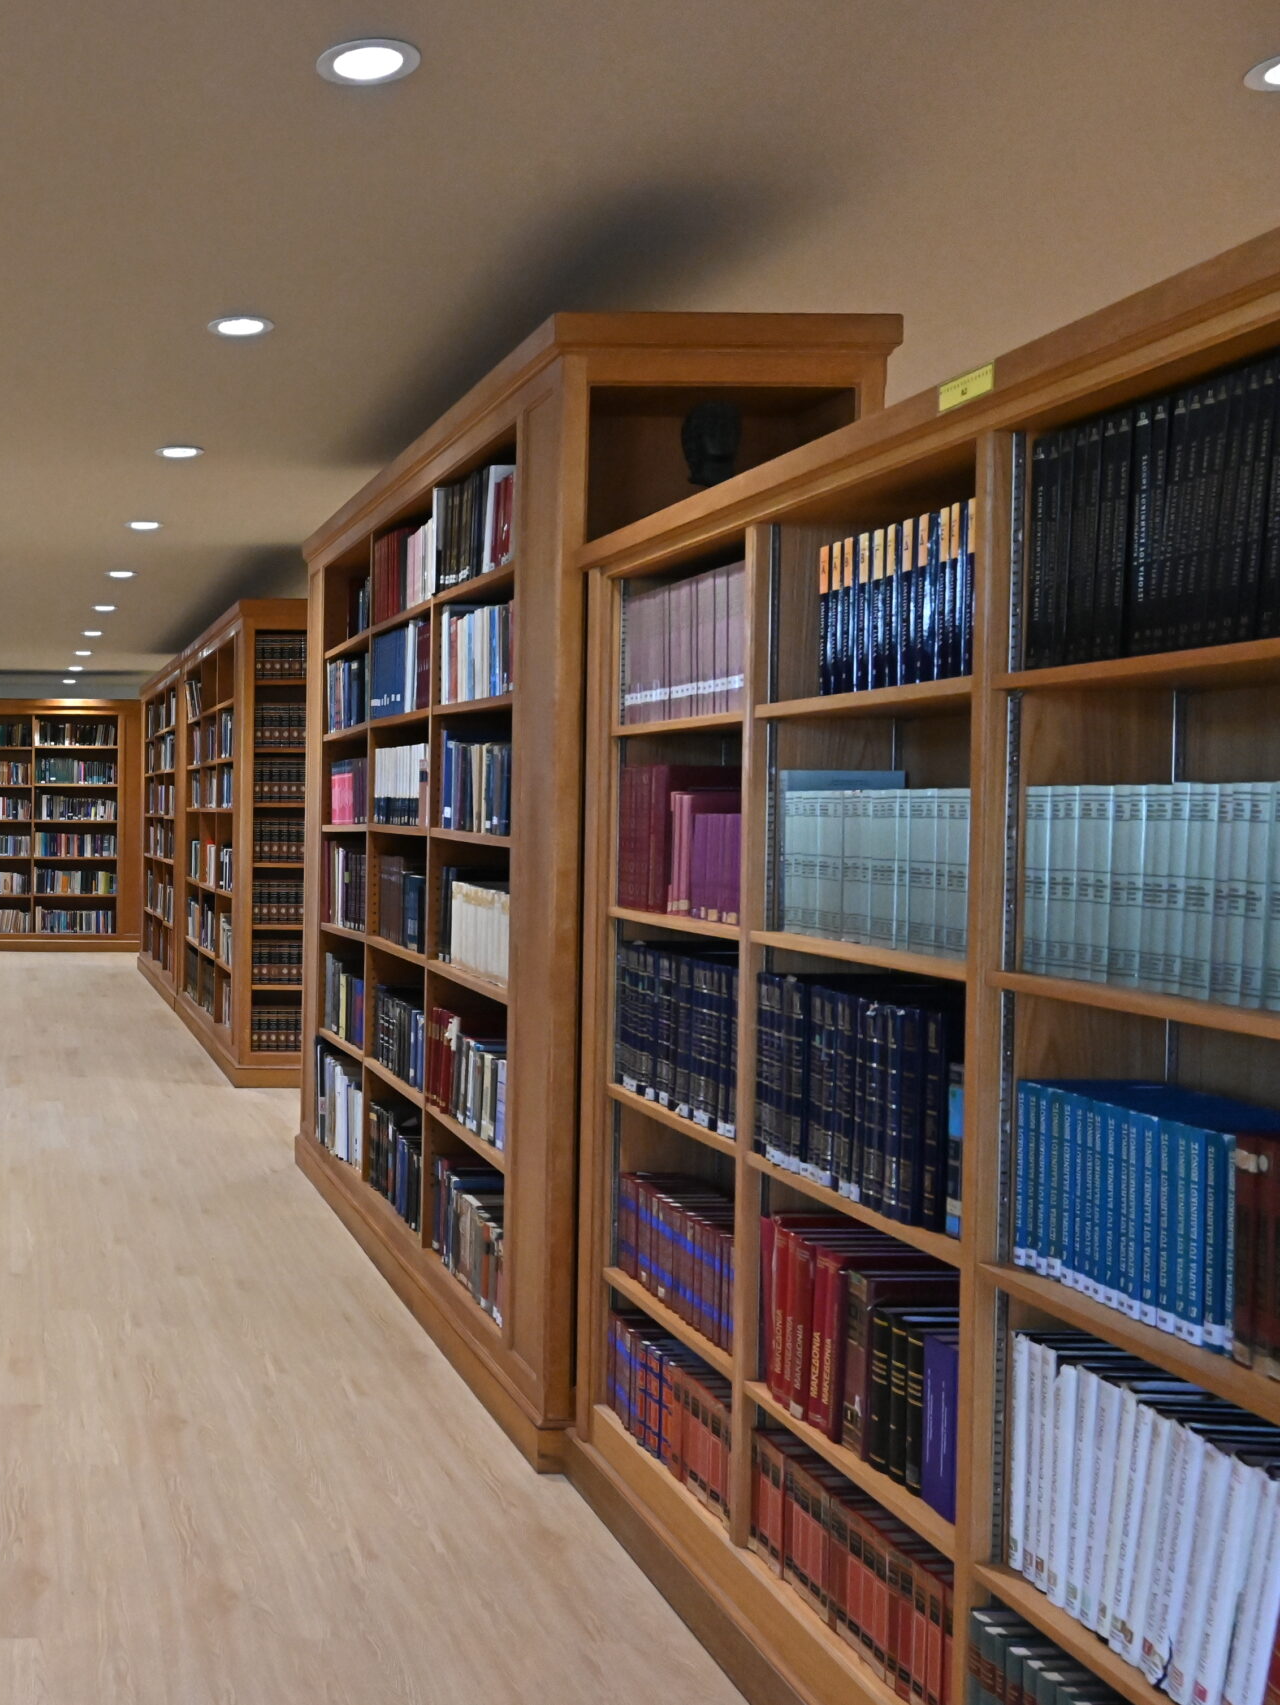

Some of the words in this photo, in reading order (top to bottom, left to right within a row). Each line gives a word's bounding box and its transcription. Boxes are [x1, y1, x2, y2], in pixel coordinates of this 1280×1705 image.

[1145, 1130, 1153, 1168] ΕΘΝΟΥΣ
[1161, 1134, 1169, 1172] ΕΘΝΟΥΣ
[1178, 1138, 1186, 1178] ΕΘΝΟΥΣ
[1191, 1143, 1199, 1182] ΕΘΝΟΥΣ
[1207, 1146, 1215, 1186] ΕΘΝΟΥΣ
[1144, 1171, 1152, 1224] ΕΛΛΗΝΙΚΟΥ
[1160, 1174, 1168, 1228] ΕΛΛΗΝΙΚΟΥ
[1190, 1185, 1198, 1240] ΕΛΛΗΝΙΚΟΥ
[1206, 1189, 1214, 1244] ΕΛΛΗΝΙΚΟΥ
[1143, 1227, 1151, 1243] ΤΟΥ
[1160, 1231, 1168, 1248] ΤΟΥ
[1189, 1242, 1197, 1260] ΤΟΥ
[1143, 1247, 1151, 1283] ΙΣΤΟΡΙΑ
[1160, 1252, 1168, 1288] ΙΣΤΟΡΙΑ
[1176, 1258, 1184, 1295] ΙΣΤΟΡΙΑ
[1189, 1263, 1197, 1300] ΙΣΤΟΡΙΑ
[1205, 1268, 1213, 1306] ΙΣΤΟΡΙΑ
[794, 1325, 803, 1390] ΜΑΚΕΔΟΝΙΑ
[810, 1332, 821, 1398] ΜΑΚΕΔΟΝΙΑ
[822, 1339, 832, 1405] ΜΑΚΕΔΟΝΙΑ
